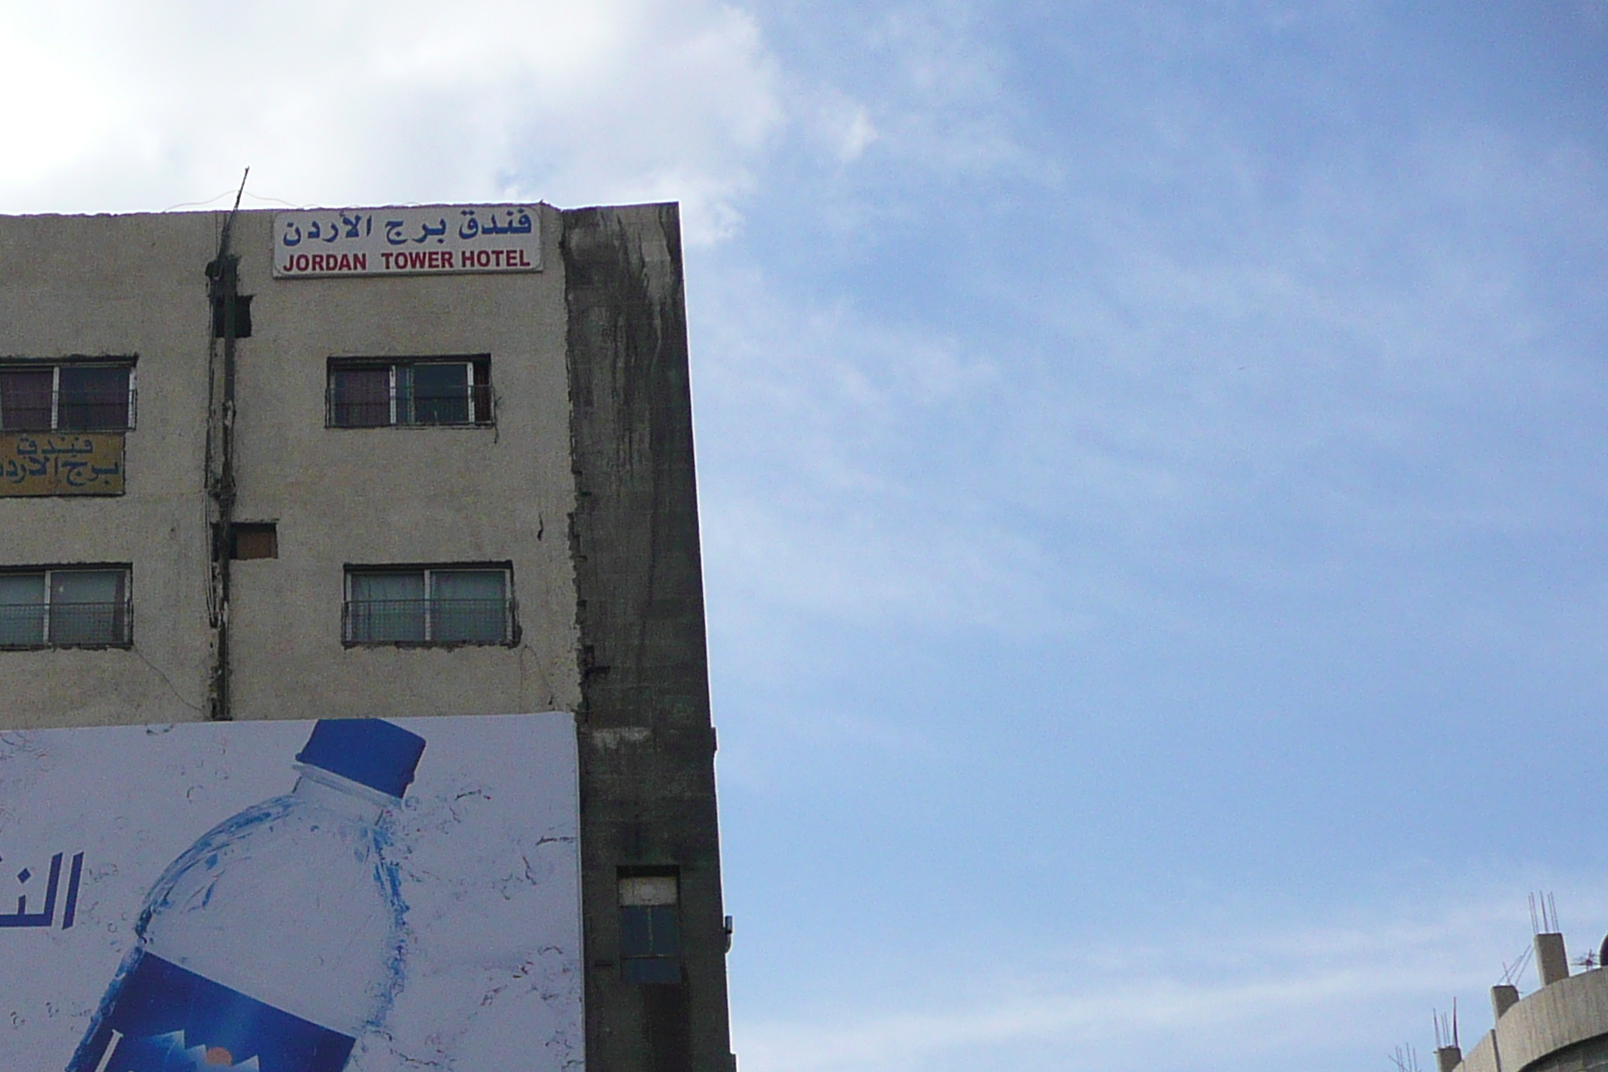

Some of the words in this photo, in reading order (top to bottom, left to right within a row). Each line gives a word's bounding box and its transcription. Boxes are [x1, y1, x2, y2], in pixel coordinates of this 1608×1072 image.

[385, 214, 446, 244] برج
[459, 208, 532, 239] فندق
[283, 253, 367, 272] JORDAN
[381, 251, 454, 270] TOWER
[461, 249, 531, 268] HOTEL
[61, 460, 120, 487] برج
